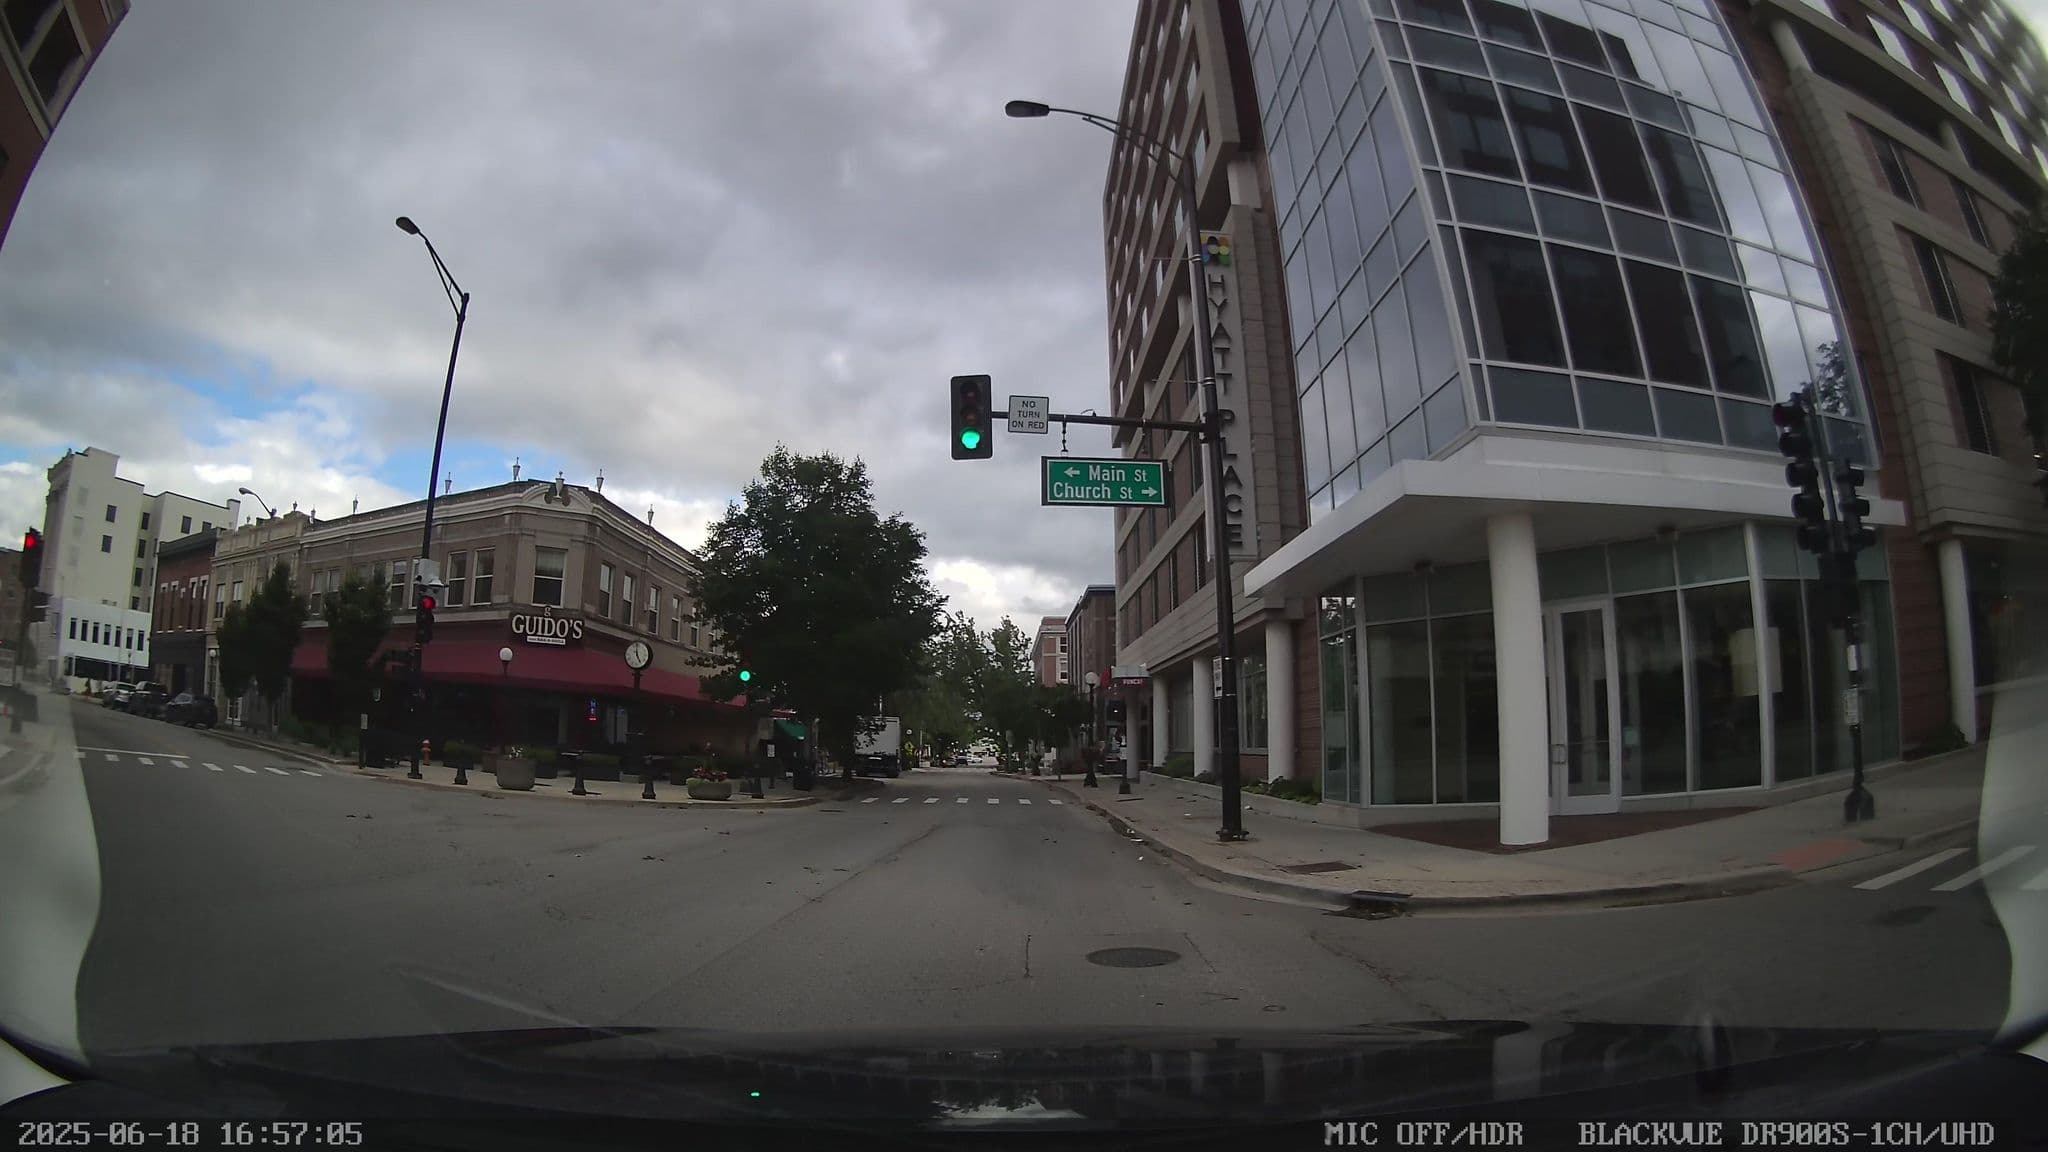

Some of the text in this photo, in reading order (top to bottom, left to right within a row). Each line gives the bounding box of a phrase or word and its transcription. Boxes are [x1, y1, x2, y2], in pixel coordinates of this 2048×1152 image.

[1017, 411, 1040, 419] TURN
[1208, 273, 1243, 548] HYATT PLACE
[1011, 420, 1045, 429] ON RED
[1089, 464, 1148, 482] Main St
[1053, 482, 1133, 500] Church St
[512, 614, 583, 639] GUIDO'S
